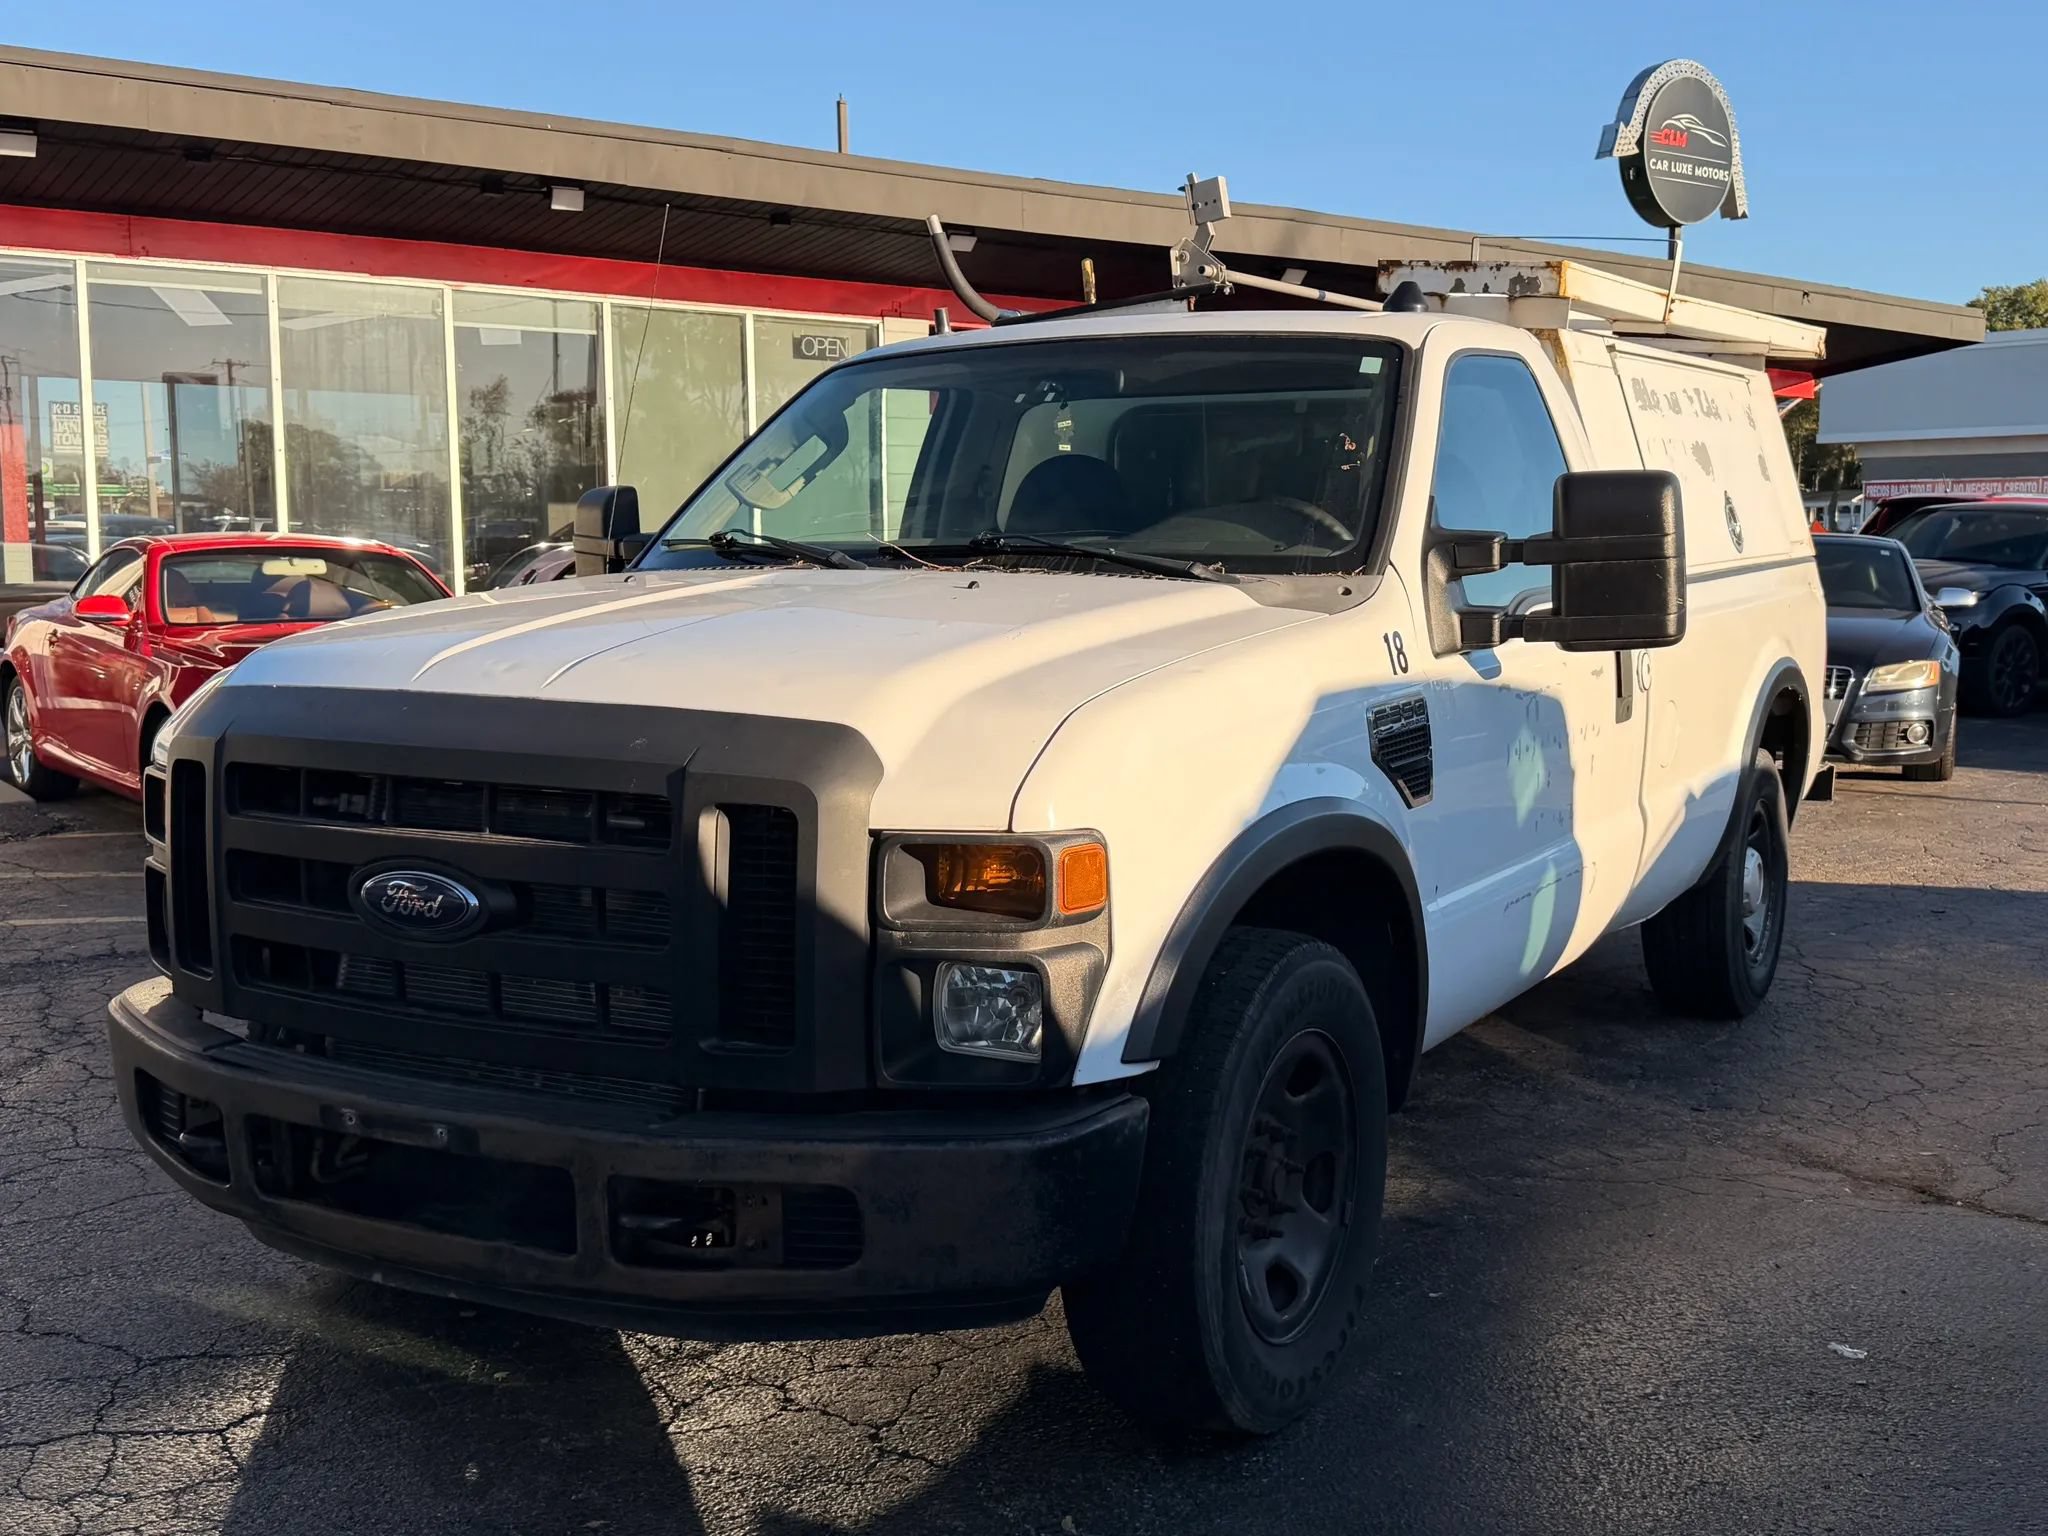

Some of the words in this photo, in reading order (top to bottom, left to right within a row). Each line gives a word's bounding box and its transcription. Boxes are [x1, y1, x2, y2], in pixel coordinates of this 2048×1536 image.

[1660, 129, 1688, 147] CLM
[1650, 157, 1669, 172] CAR
[1671, 161, 1693, 176] LUXE
[1695, 166, 1729, 181] MOTORS
[802, 336, 848, 358] OPEN
[73, 404, 107, 415] SICE
[1966, 482, 2002, 494] NECESITA
[1383, 631, 1408, 675] 18
[381, 880, 443, 918] Ford
